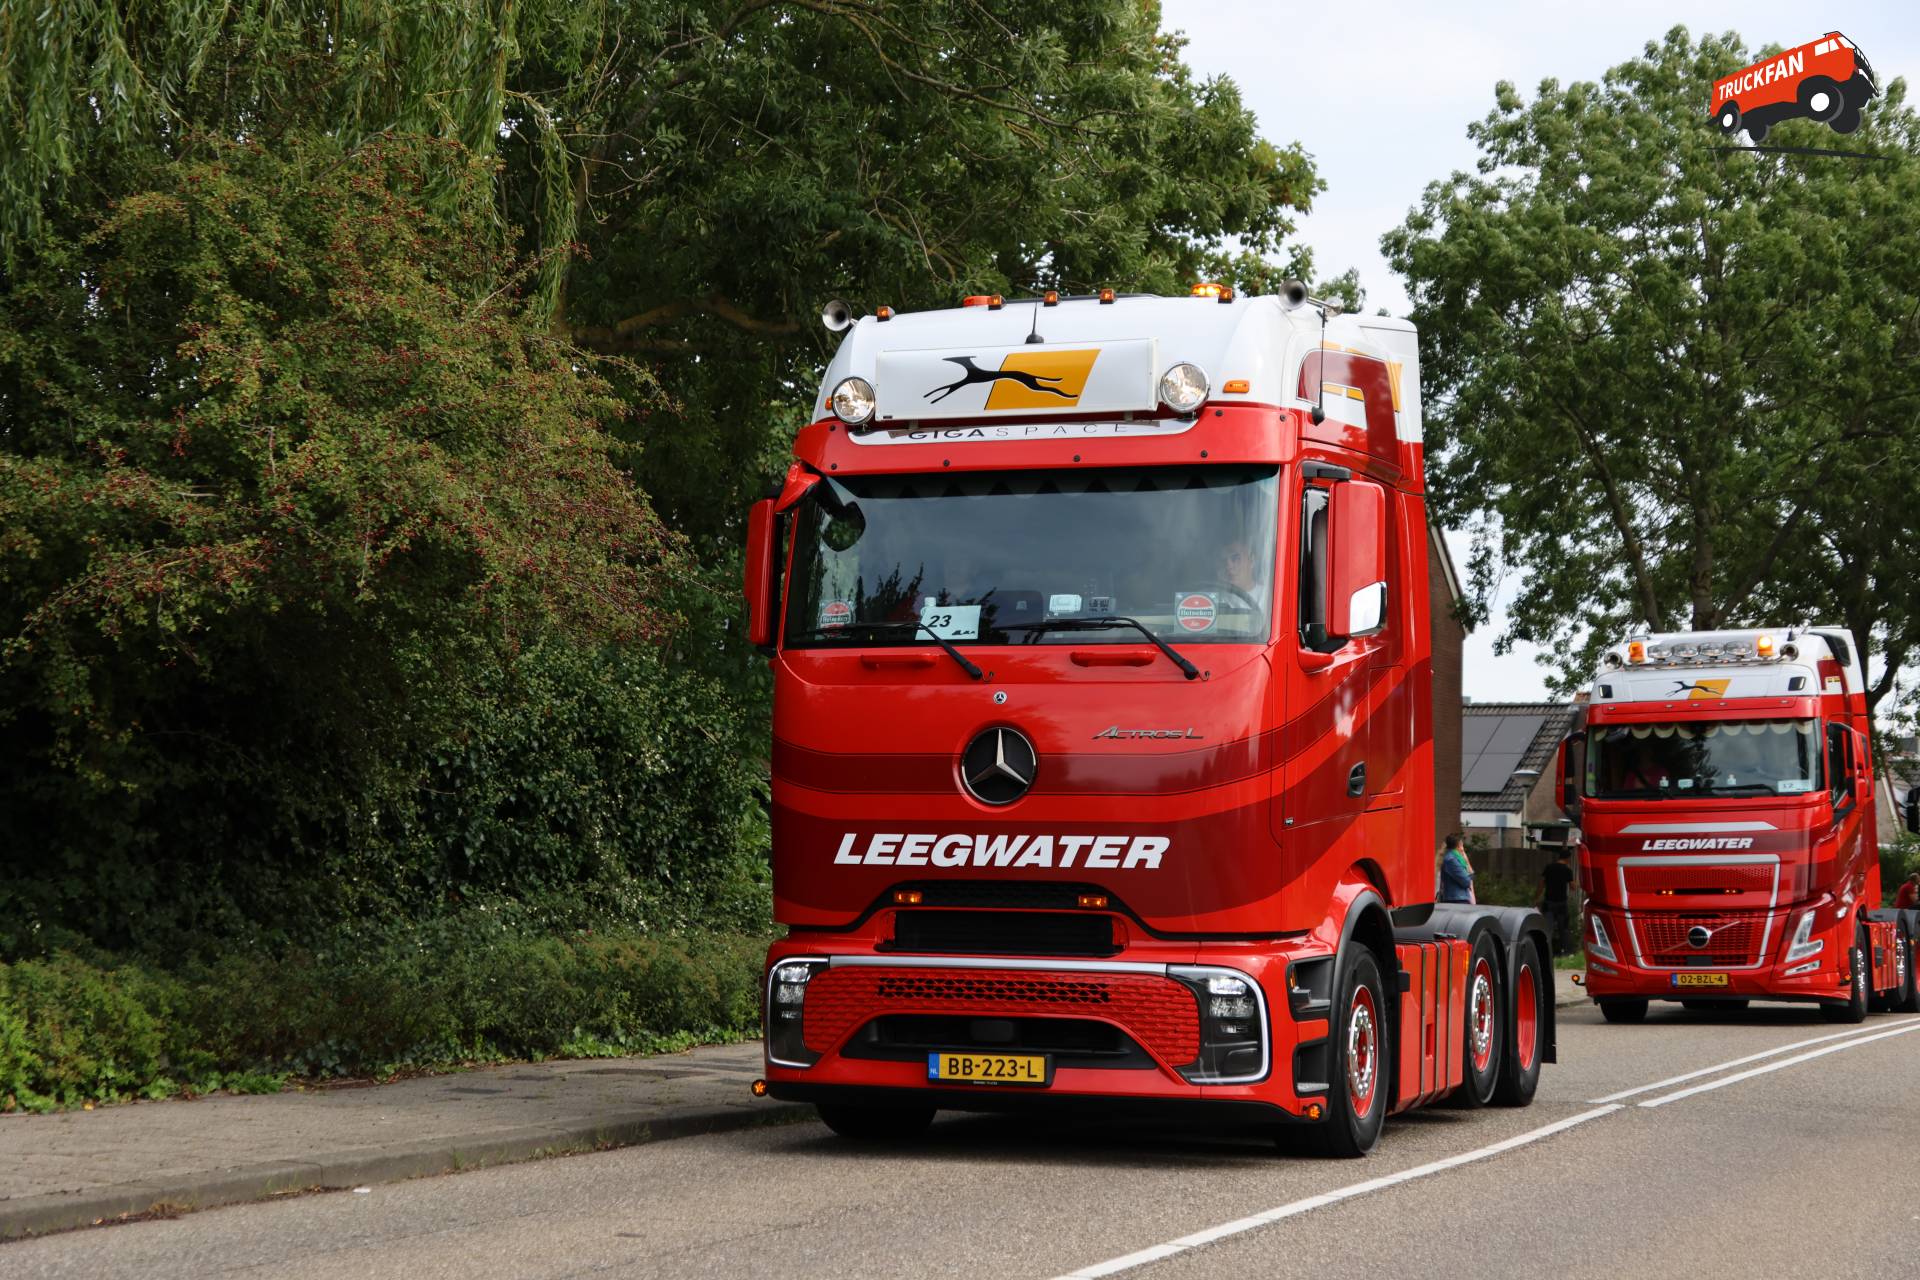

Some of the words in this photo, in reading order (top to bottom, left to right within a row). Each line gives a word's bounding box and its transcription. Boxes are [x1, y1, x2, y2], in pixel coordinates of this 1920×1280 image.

[928, 614, 952, 628] 23
[1185, 727, 1205, 739] L
[1642, 837, 1754, 850] LEEGWATER
[833, 832, 1171, 869] LEEGWATER
[1680, 975, 1723, 984] 02-BZL-4
[948, 1057, 1038, 1078] BB-223-L
